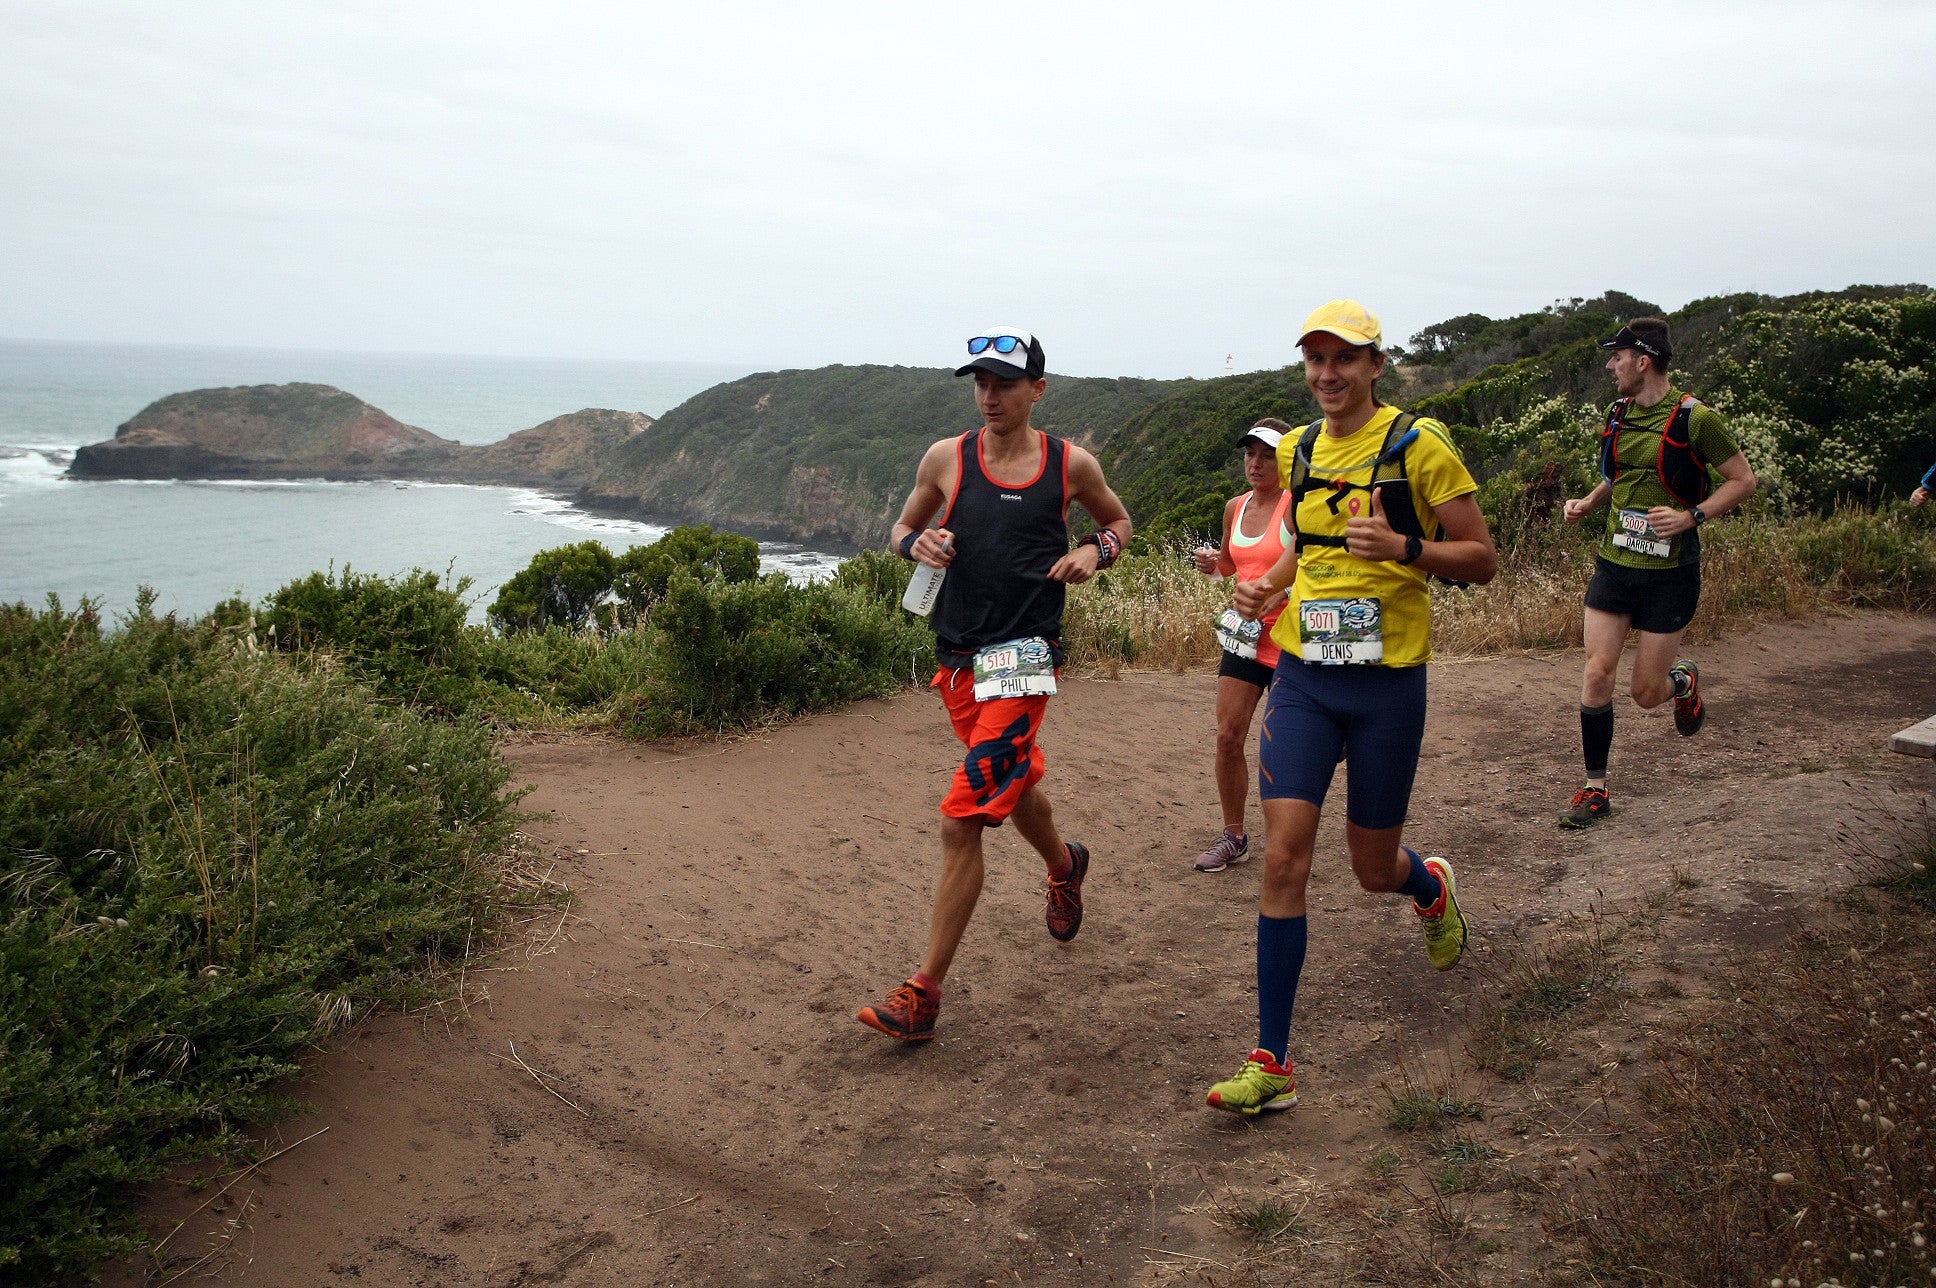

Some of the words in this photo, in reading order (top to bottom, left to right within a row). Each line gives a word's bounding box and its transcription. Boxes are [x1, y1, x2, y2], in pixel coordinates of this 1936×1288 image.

[1625, 517, 1645, 531] 5002
[1626, 537, 1655, 552] DARREN
[919, 572, 939, 610] ULTIMATE
[1309, 612, 1334, 630] 5071
[987, 650, 1012, 669] 5137
[1322, 644, 1353, 660] DENIS
[1001, 677, 1031, 693] PHILL
